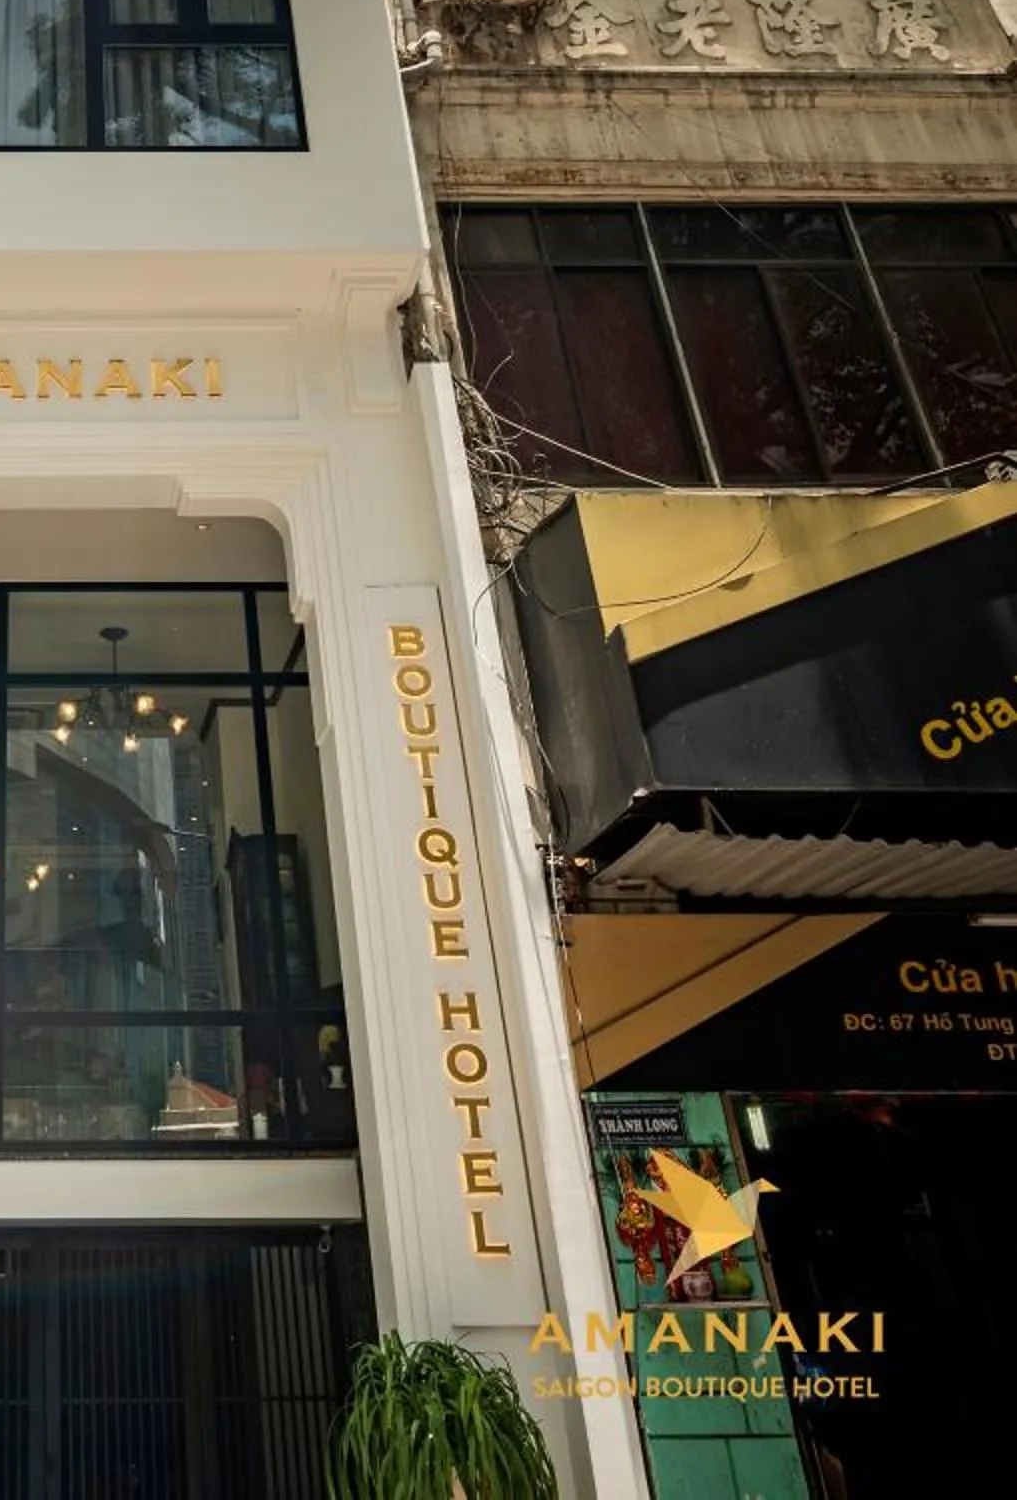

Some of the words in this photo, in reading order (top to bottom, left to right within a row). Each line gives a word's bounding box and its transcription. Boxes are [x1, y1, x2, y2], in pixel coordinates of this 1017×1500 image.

[388, 625, 470, 959] BOUTIQUE
[437, 991, 512, 1256] HOTEL
[899, 958, 983, 993] Cửa
[889, 1013, 914, 1032] 67
